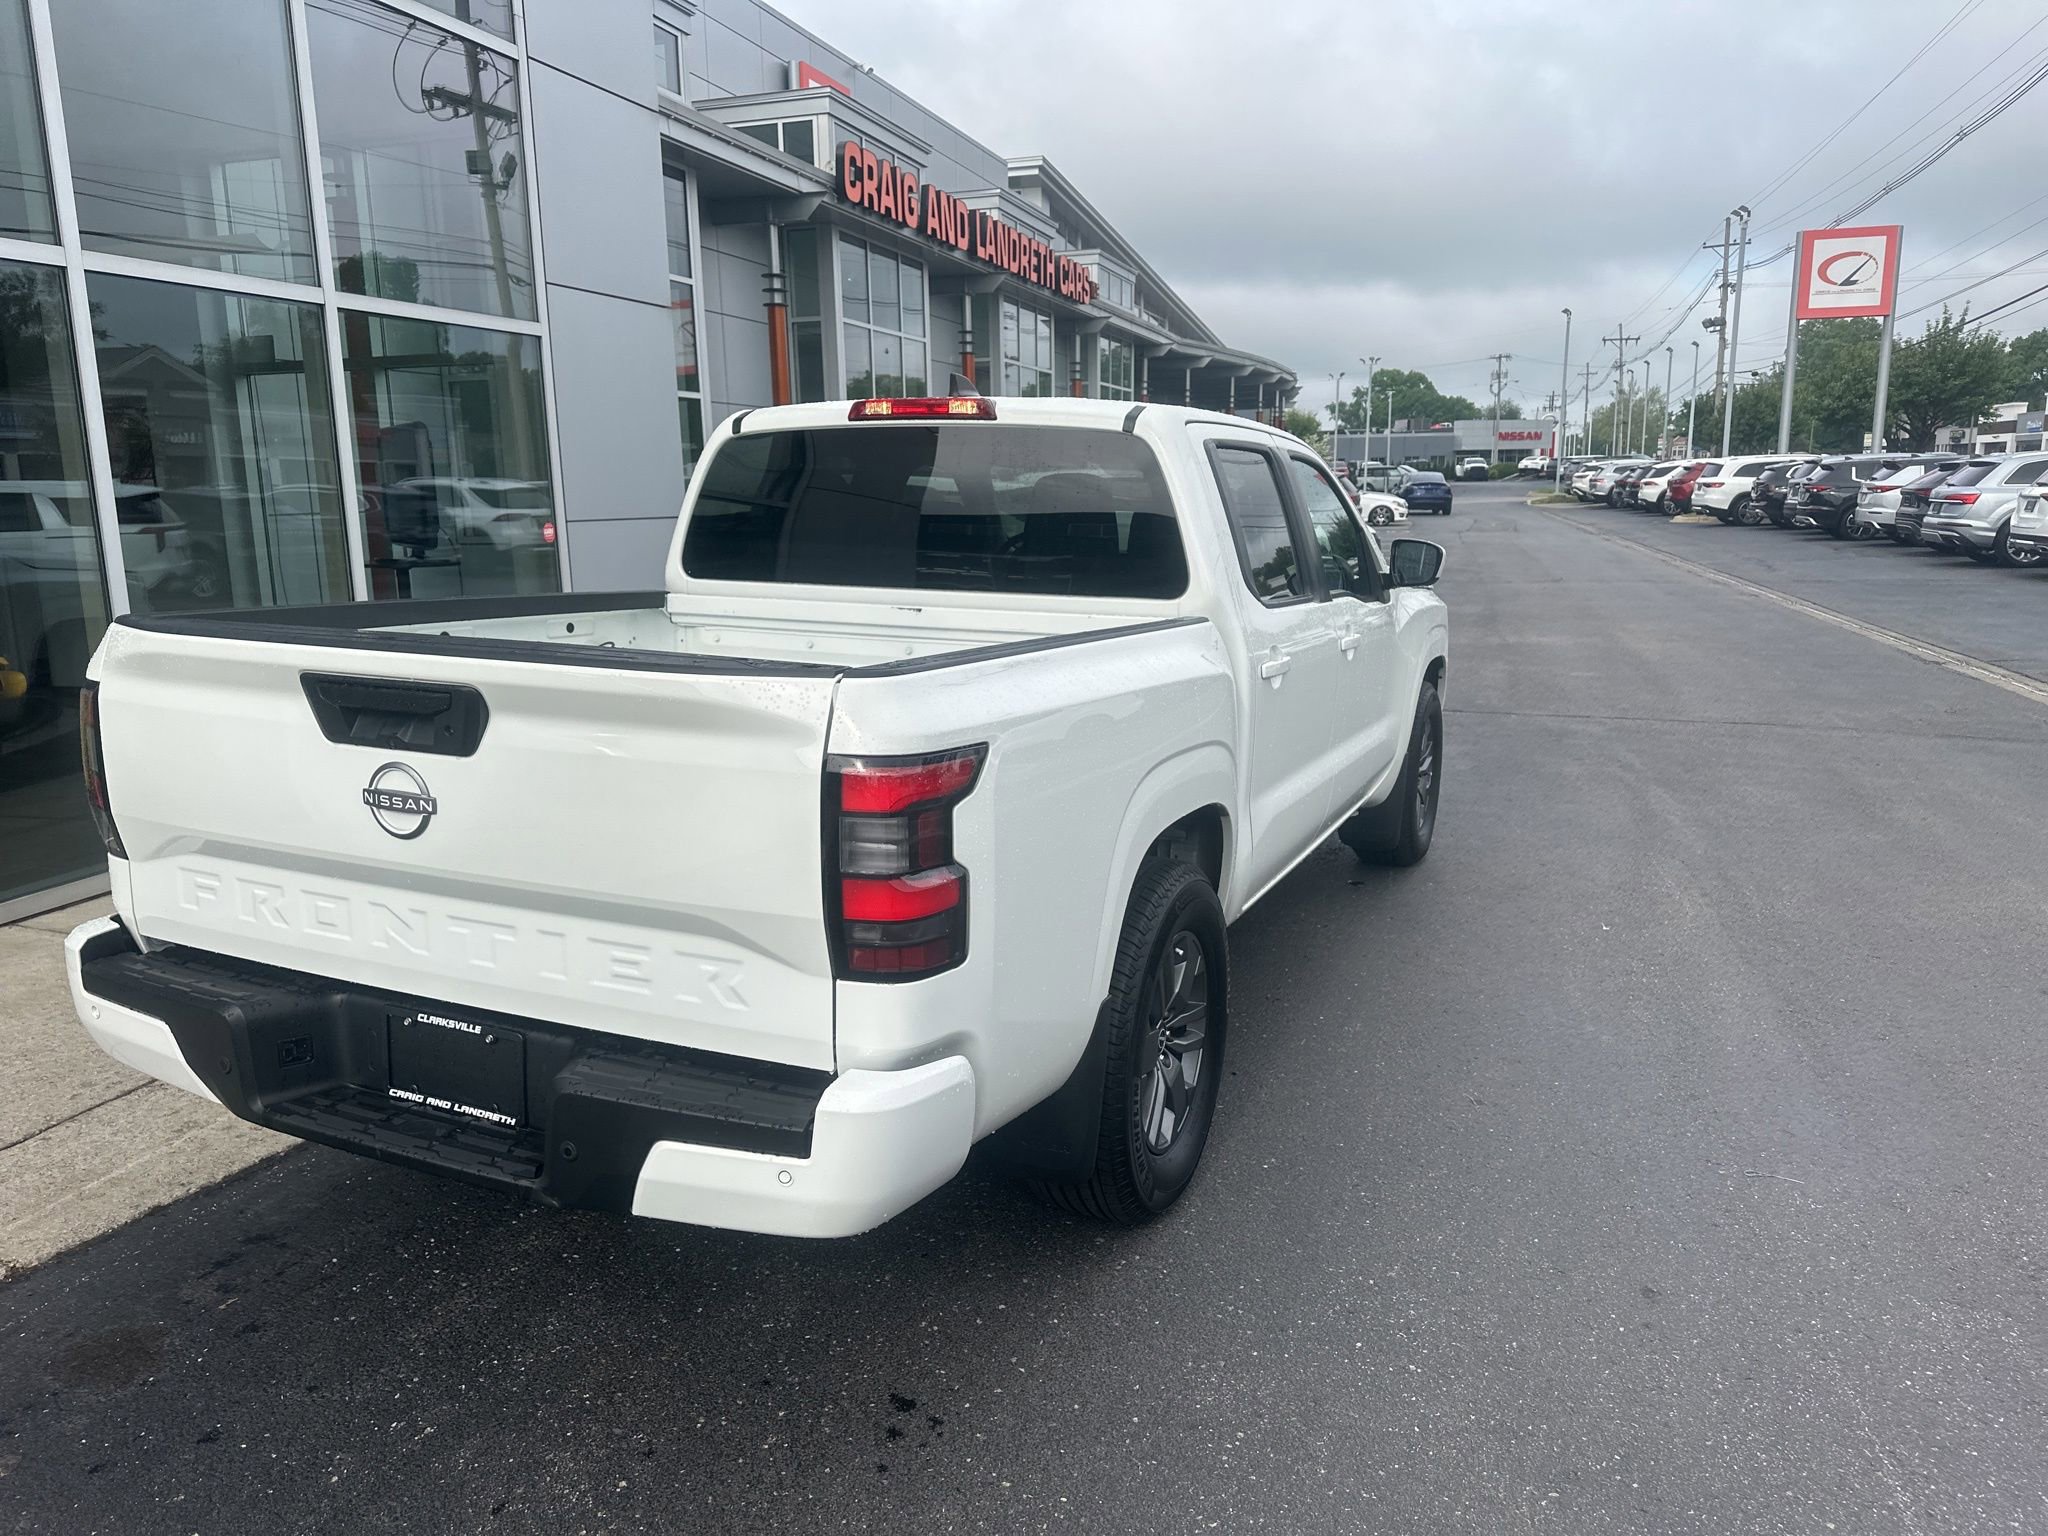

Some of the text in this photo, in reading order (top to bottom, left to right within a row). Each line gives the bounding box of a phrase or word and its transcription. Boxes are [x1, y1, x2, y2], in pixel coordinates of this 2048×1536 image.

[843, 140, 1091, 305] CRAIG AND LANDRETH CARS
[1498, 431, 1543, 441] NISSAN
[363, 791, 434, 812] NISSAN
[177, 865, 751, 1011] FRONTIER
[417, 1013, 482, 1034] CLARKSVILLE
[388, 1087, 516, 1126] CRAIG AND LANDRETH
[1132, 1081, 1148, 1174] MICHELIN
